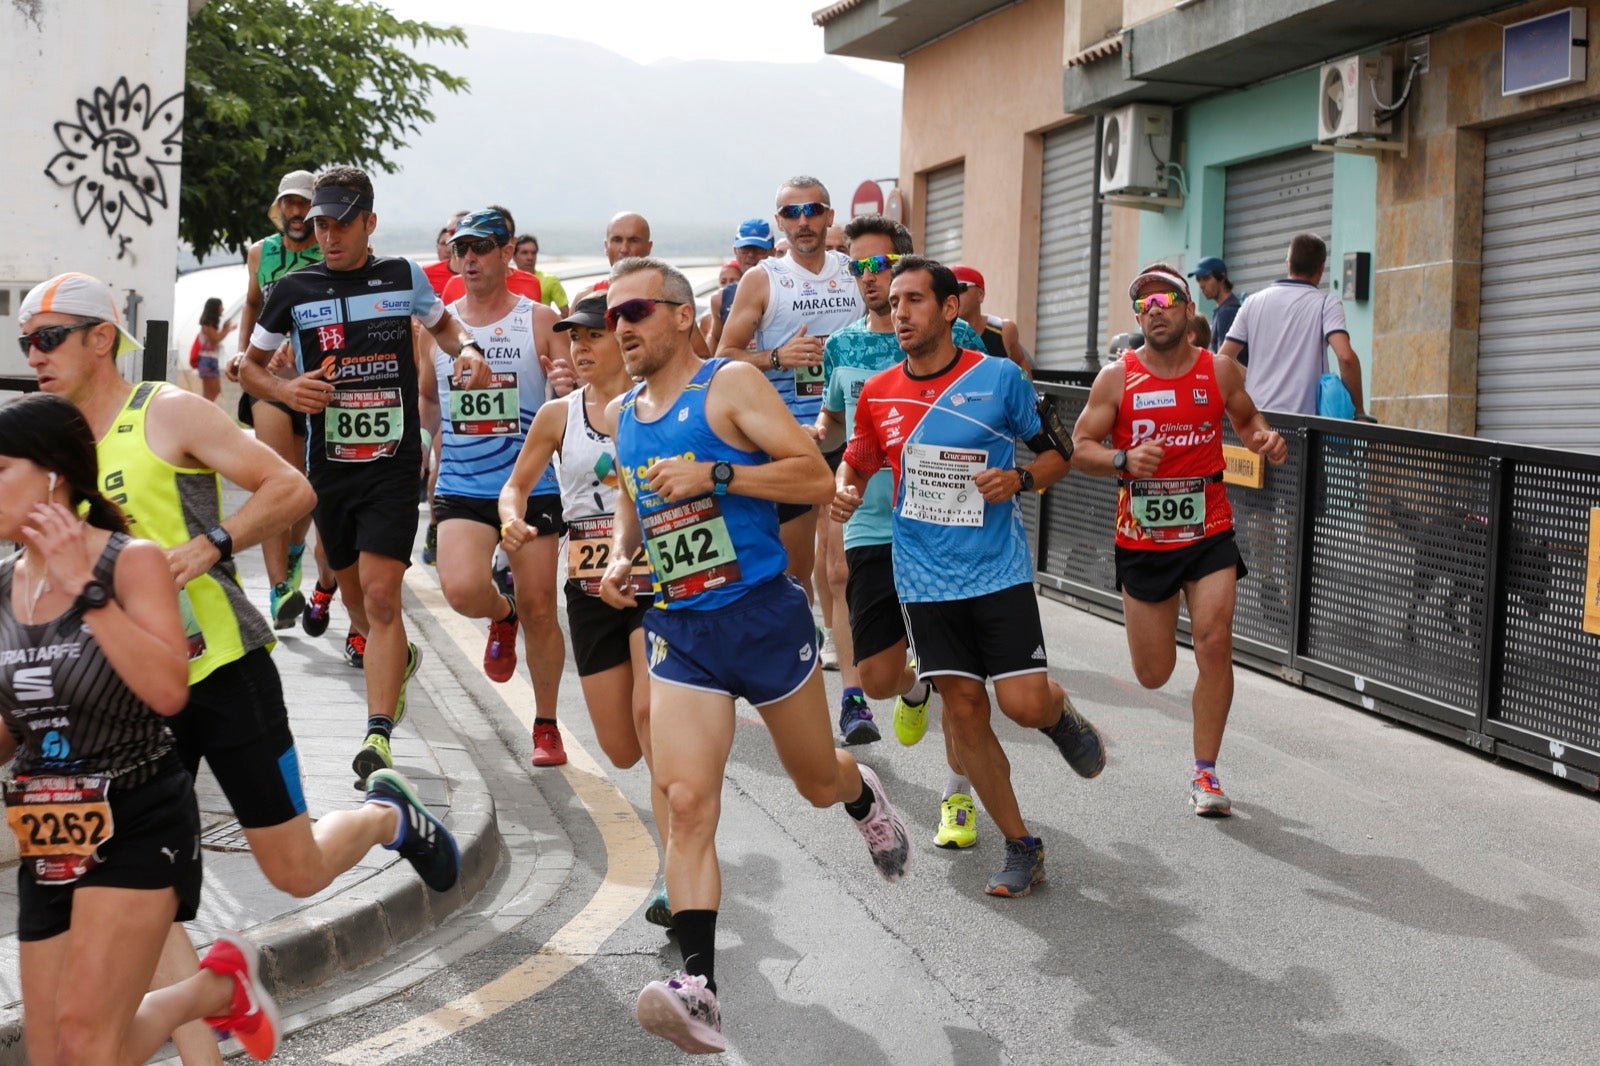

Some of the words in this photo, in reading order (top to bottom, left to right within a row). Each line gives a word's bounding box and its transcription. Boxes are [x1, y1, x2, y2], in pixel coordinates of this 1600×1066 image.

[792, 297, 857, 311] MARACENA
[363, 372, 399, 382] pedidos
[461, 392, 505, 416] 861
[338, 412, 390, 438] 865
[943, 451, 977, 462] Cruzcampo
[907, 467, 916, 475] YO
[918, 470, 946, 479] CORRO
[931, 480, 966, 489] CANCER
[918, 489, 946, 500] aecc
[957, 490, 968, 503] 6
[662, 507, 683, 523] PREMIO
[682, 503, 692, 515] DE
[691, 497, 713, 513] FONDO
[1145, 497, 1194, 522] 596
[583, 520, 597, 530] GRAN
[597, 518, 614, 529] PREMI
[579, 543, 648, 570] 222
[657, 527, 719, 574] 542
[21, 811, 105, 846] 2262
